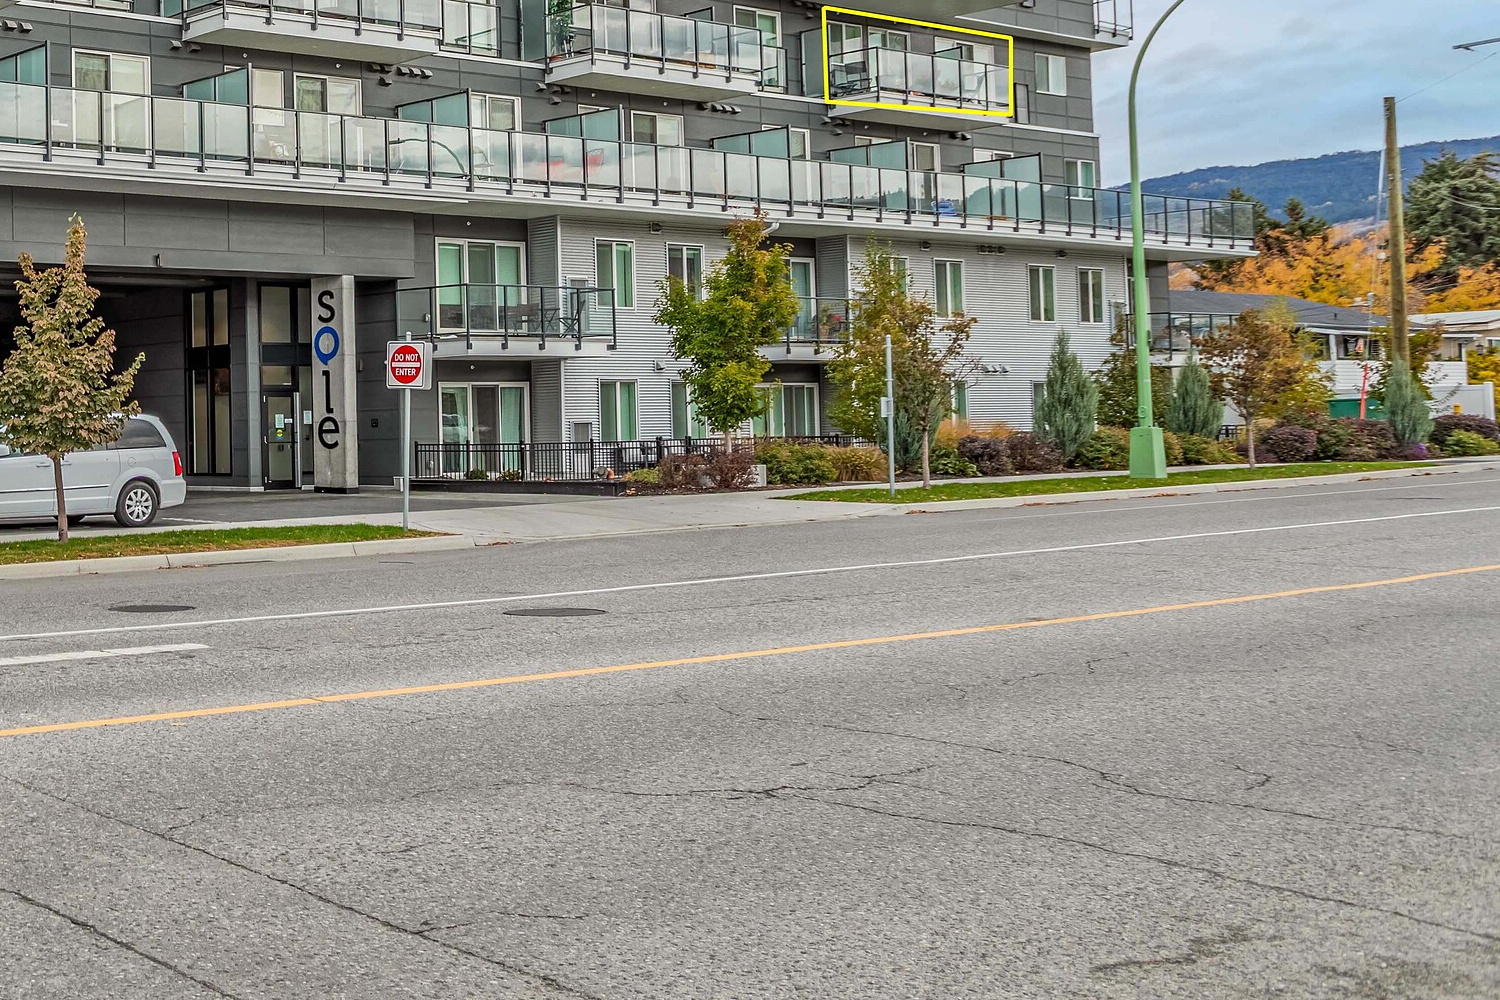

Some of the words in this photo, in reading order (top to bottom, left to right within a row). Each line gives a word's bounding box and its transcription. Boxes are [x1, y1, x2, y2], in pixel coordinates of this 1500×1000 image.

[394, 353, 404, 361] DO
[405, 353, 418, 361] NOT
[395, 368, 416, 376] ENTER
